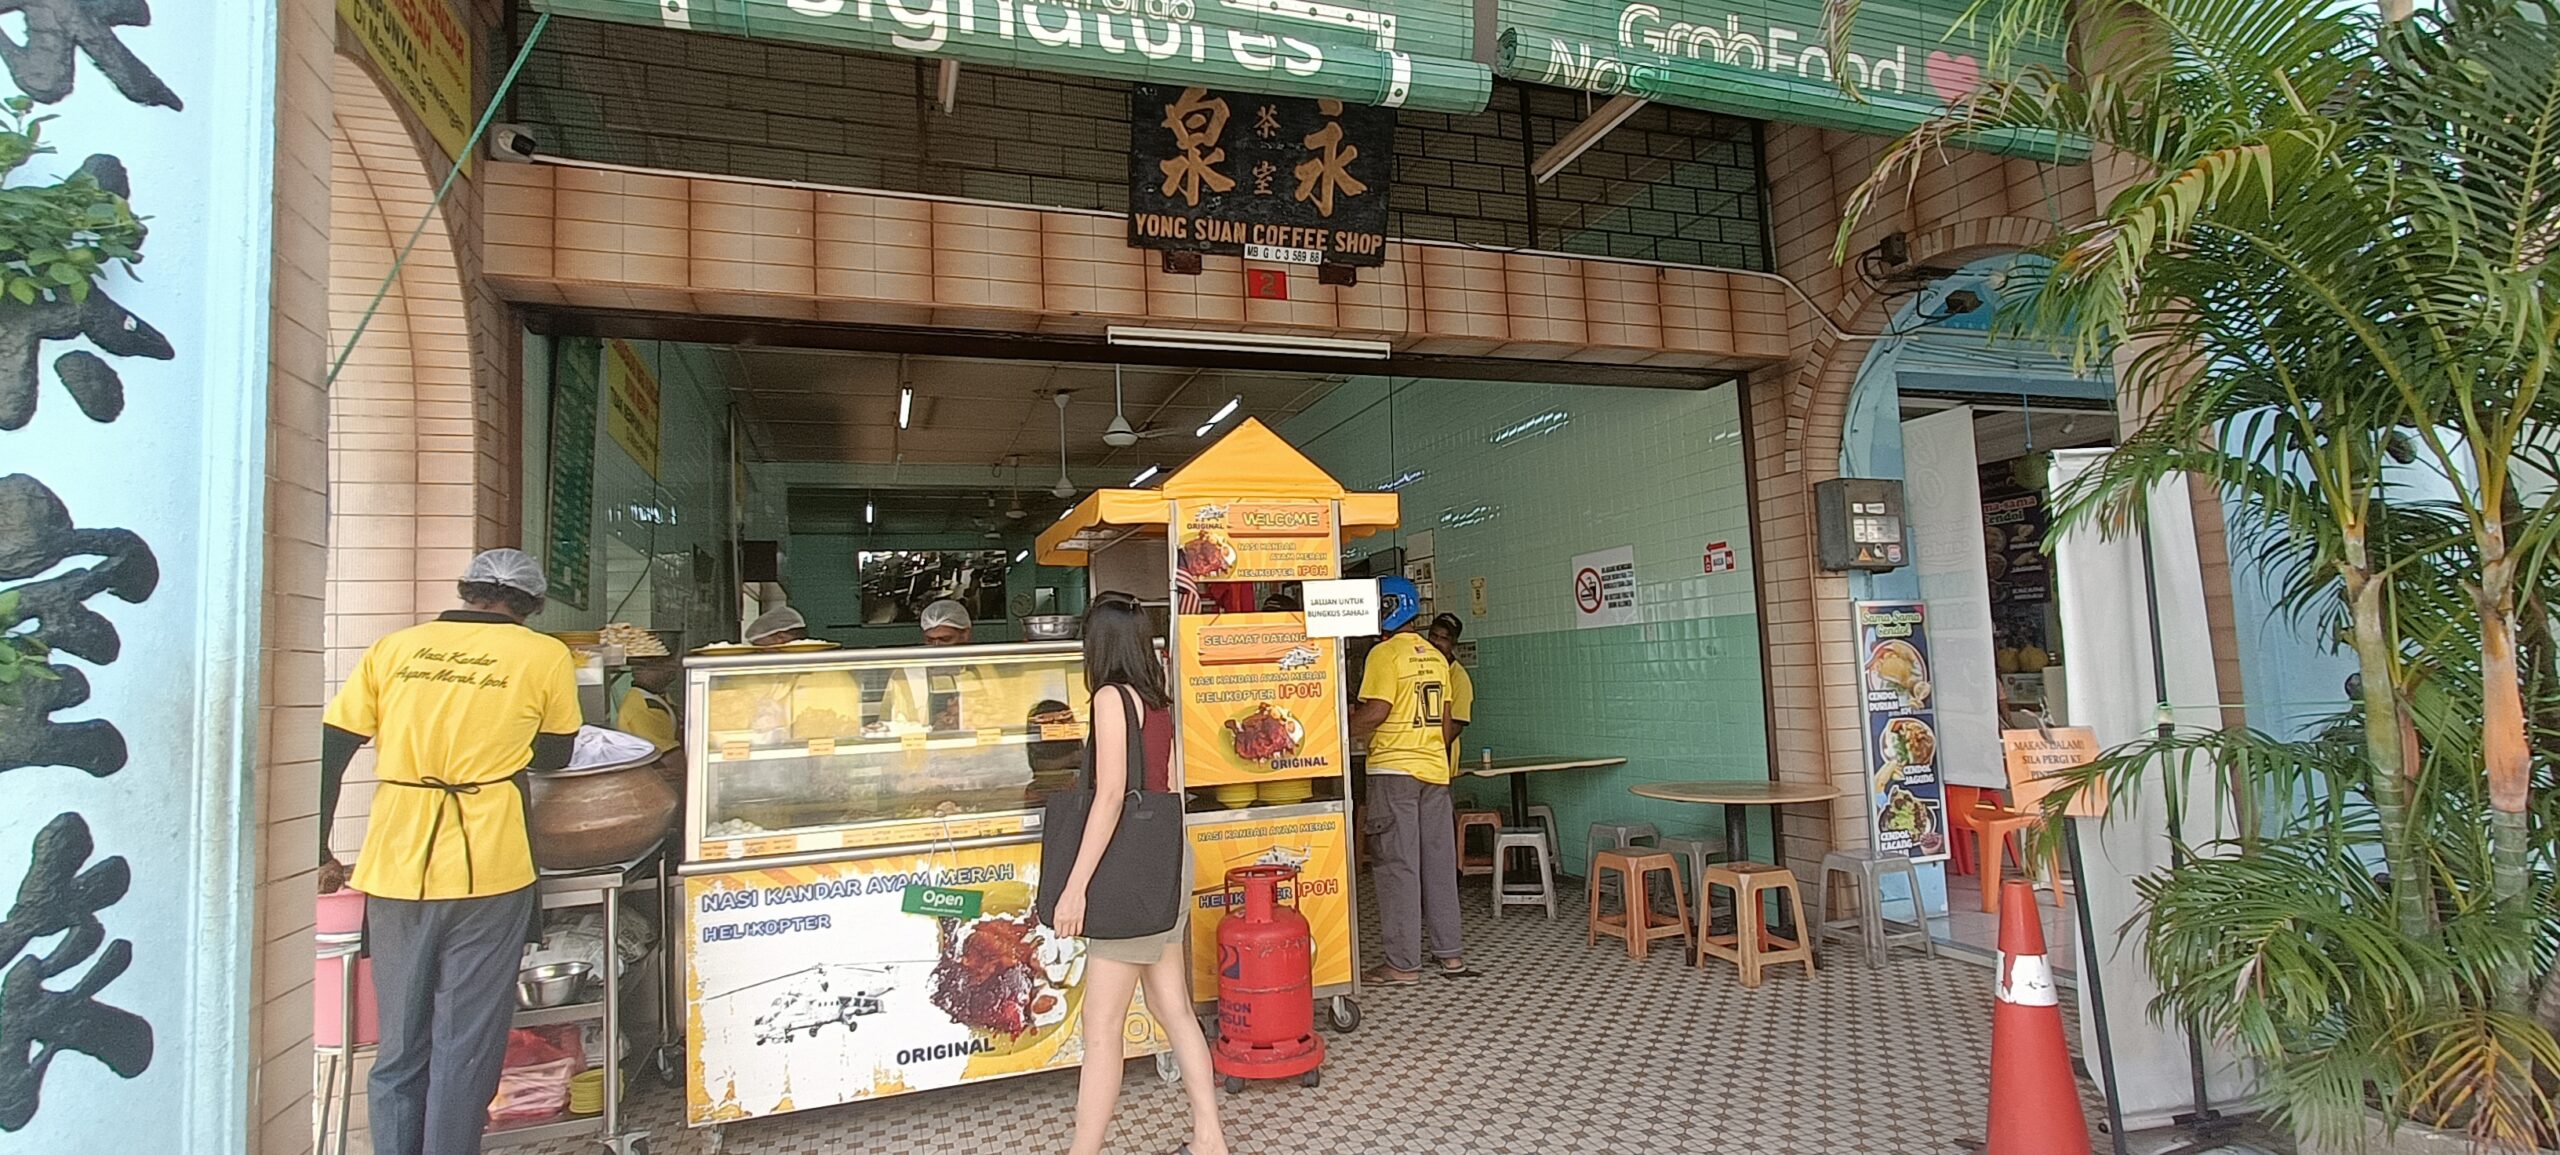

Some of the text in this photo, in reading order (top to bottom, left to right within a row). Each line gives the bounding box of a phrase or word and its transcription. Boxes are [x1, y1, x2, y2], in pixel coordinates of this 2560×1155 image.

[1134, 212, 1383, 256] YONG SUAN COFFEE SHOP
[1261, 272, 1277, 296] 2
[1186, 522, 1225, 530] ORIGINAL
[1242, 511, 1319, 527] WELCOME
[1237, 542, 1258, 551] NASI
[1269, 552, 1328, 561] AYAM MERAH
[1237, 564, 1328, 578] HELIKOPTER IPOH
[1310, 597, 1364, 606] LALUAN UNTUK
[1307, 609, 1341, 618] BUNGKUS
[1862, 609, 1921, 624] Sama Sama
[1875, 623, 1913, 637] Cendol
[1204, 632, 1307, 647] SELAMAT DATANG
[413, 647, 448, 662] Nasi
[394, 665, 510, 690] Ayam Merah Ipoh
[1189, 670, 1327, 687] NASI KANDAR AYAM MERAH
[1195, 681, 1322, 704] HELIKOPTER IPOH
[1868, 690, 1898, 701] CENDOL
[1411, 680, 1444, 729] 10
[1869, 700, 1900, 712] DURIAN
[2013, 740, 2048, 751] MAKAN
[1270, 756, 1328, 770] ORIGINAL
[2022, 754, 2082, 765] SILA PERGI KE
[1903, 764, 1932, 775] CENDOL
[1904, 774, 1935, 786] JAGUNG
[1197, 820, 1336, 842] NASI KANDAR AYAM MERAH
[1880, 830, 1910, 842] CENDOL
[1881, 840, 1913, 851] KACANG
[702, 863, 1015, 913] NASI KANDAR AYAM MERAH
[922, 889, 964, 908] Open
[1199, 885, 1293, 909] HELIKER
[703, 913, 832, 944] HELIKOPTER
[896, 1037, 996, 1066] ORIGINAL
